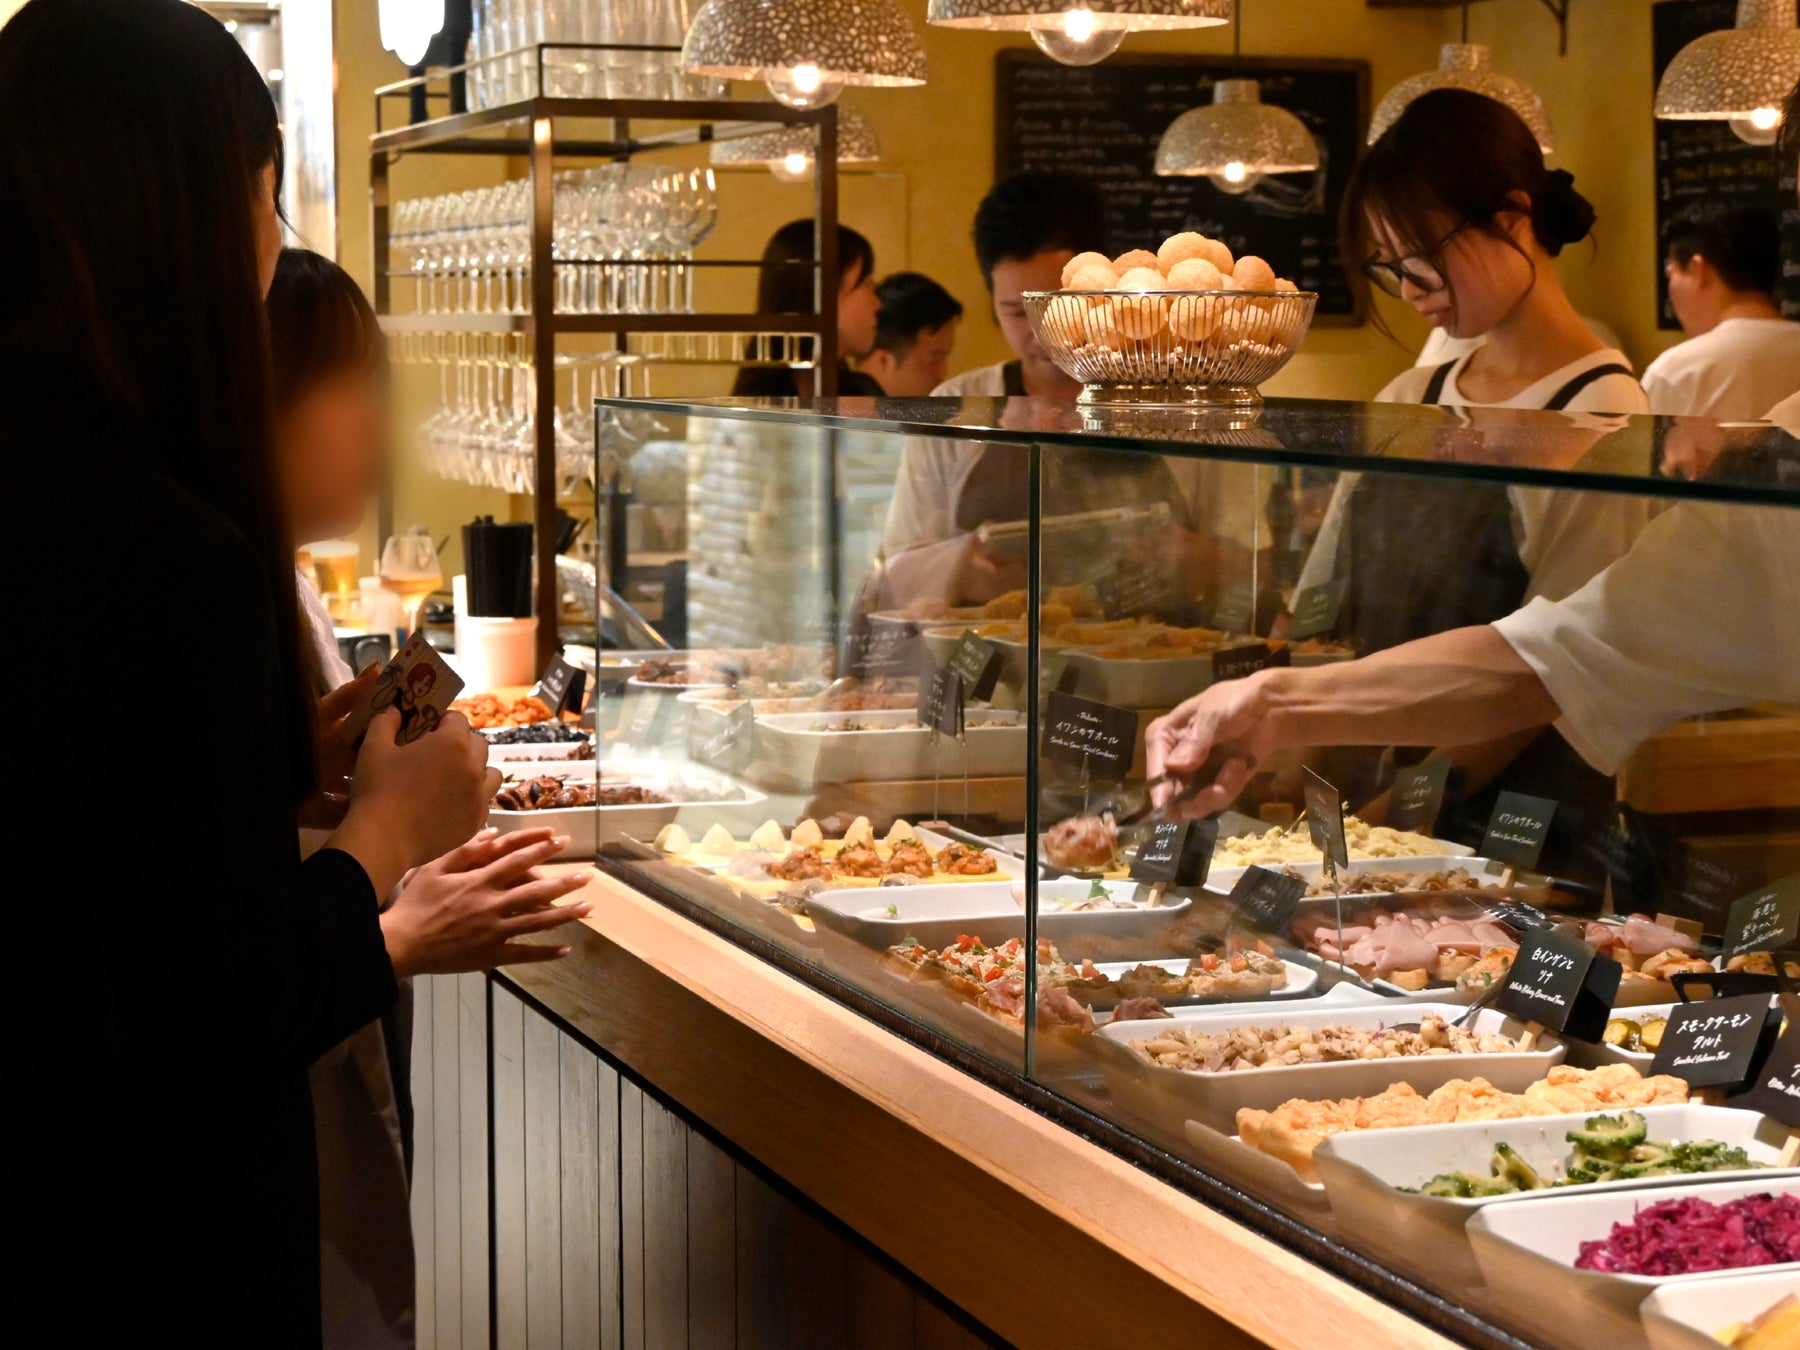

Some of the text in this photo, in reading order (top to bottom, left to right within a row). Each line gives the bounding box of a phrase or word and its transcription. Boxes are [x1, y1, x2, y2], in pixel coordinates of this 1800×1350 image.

[1531, 947, 1574, 970] 白インゲンと
[1537, 969, 1554, 984] ツナ
[1676, 1013, 1752, 1034] スモークサーモン
[1692, 1033, 1722, 1050] タルト
